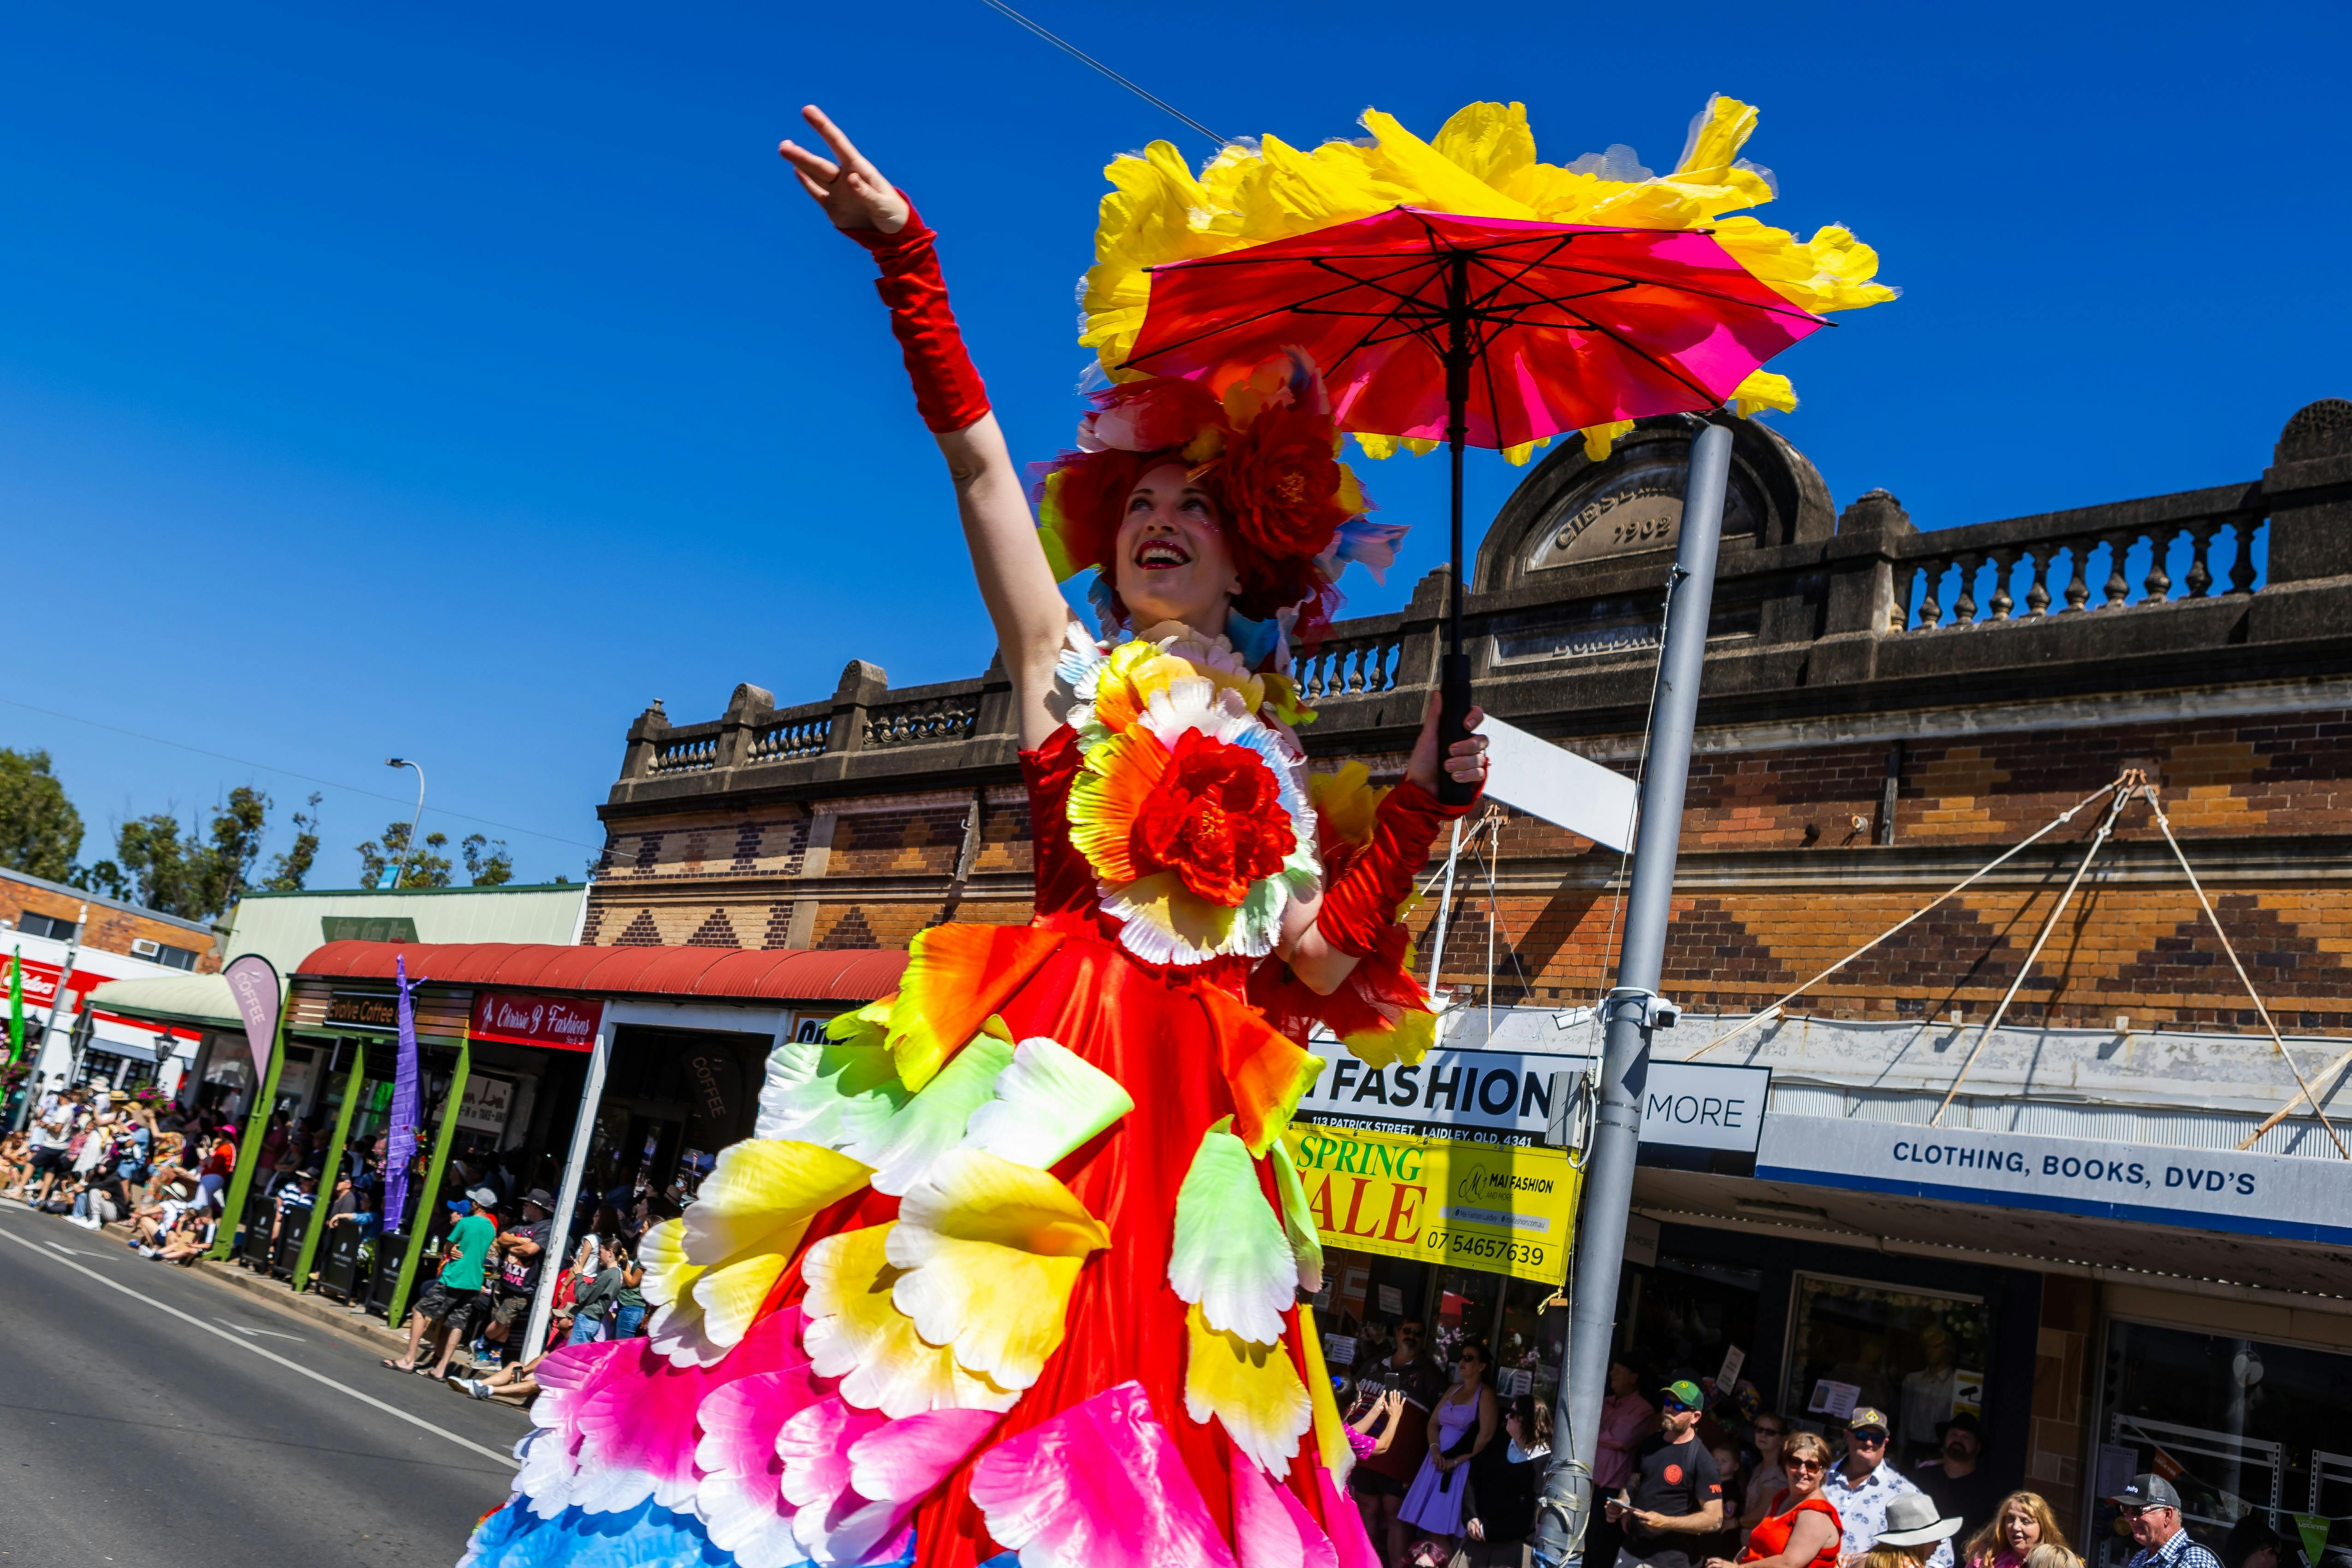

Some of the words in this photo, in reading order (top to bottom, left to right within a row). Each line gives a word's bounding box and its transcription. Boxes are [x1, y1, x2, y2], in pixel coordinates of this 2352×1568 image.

[1552, 626, 1657, 657] BUILDIN
[235, 972, 266, 1026] COFFEE
[328, 998, 359, 1020] Evolve
[360, 1000, 394, 1023] Coffee
[547, 1004, 590, 1035] Fashions
[693, 1057, 726, 1118] COFFEE
[1329, 1058, 1555, 1119] FASHION
[1646, 1093, 1745, 1128] MORE
[1312, 1117, 1327, 1125] 113
[1330, 1117, 1373, 1131] PATRICK
[1503, 1135, 1532, 1147] 4341
[1296, 1136, 1424, 1181] SPRING
[1893, 1142, 2030, 1177] CLOTHING,
[2042, 1155, 2151, 1189] BOOKS,
[2165, 1166, 2256, 1195] DVD'S
[1485, 1191, 1498, 1200] AND
[1499, 1193, 1514, 1202] MORE
[1489, 1173, 1509, 1188] MAI
[1509, 1176, 1554, 1194] FASHION
[1468, 1211, 1483, 1219] Fashion
[1427, 1231, 1449, 1249] 07
[1452, 1235, 1544, 1266] 54657639
[1632, 1234, 1655, 1250] MORE
